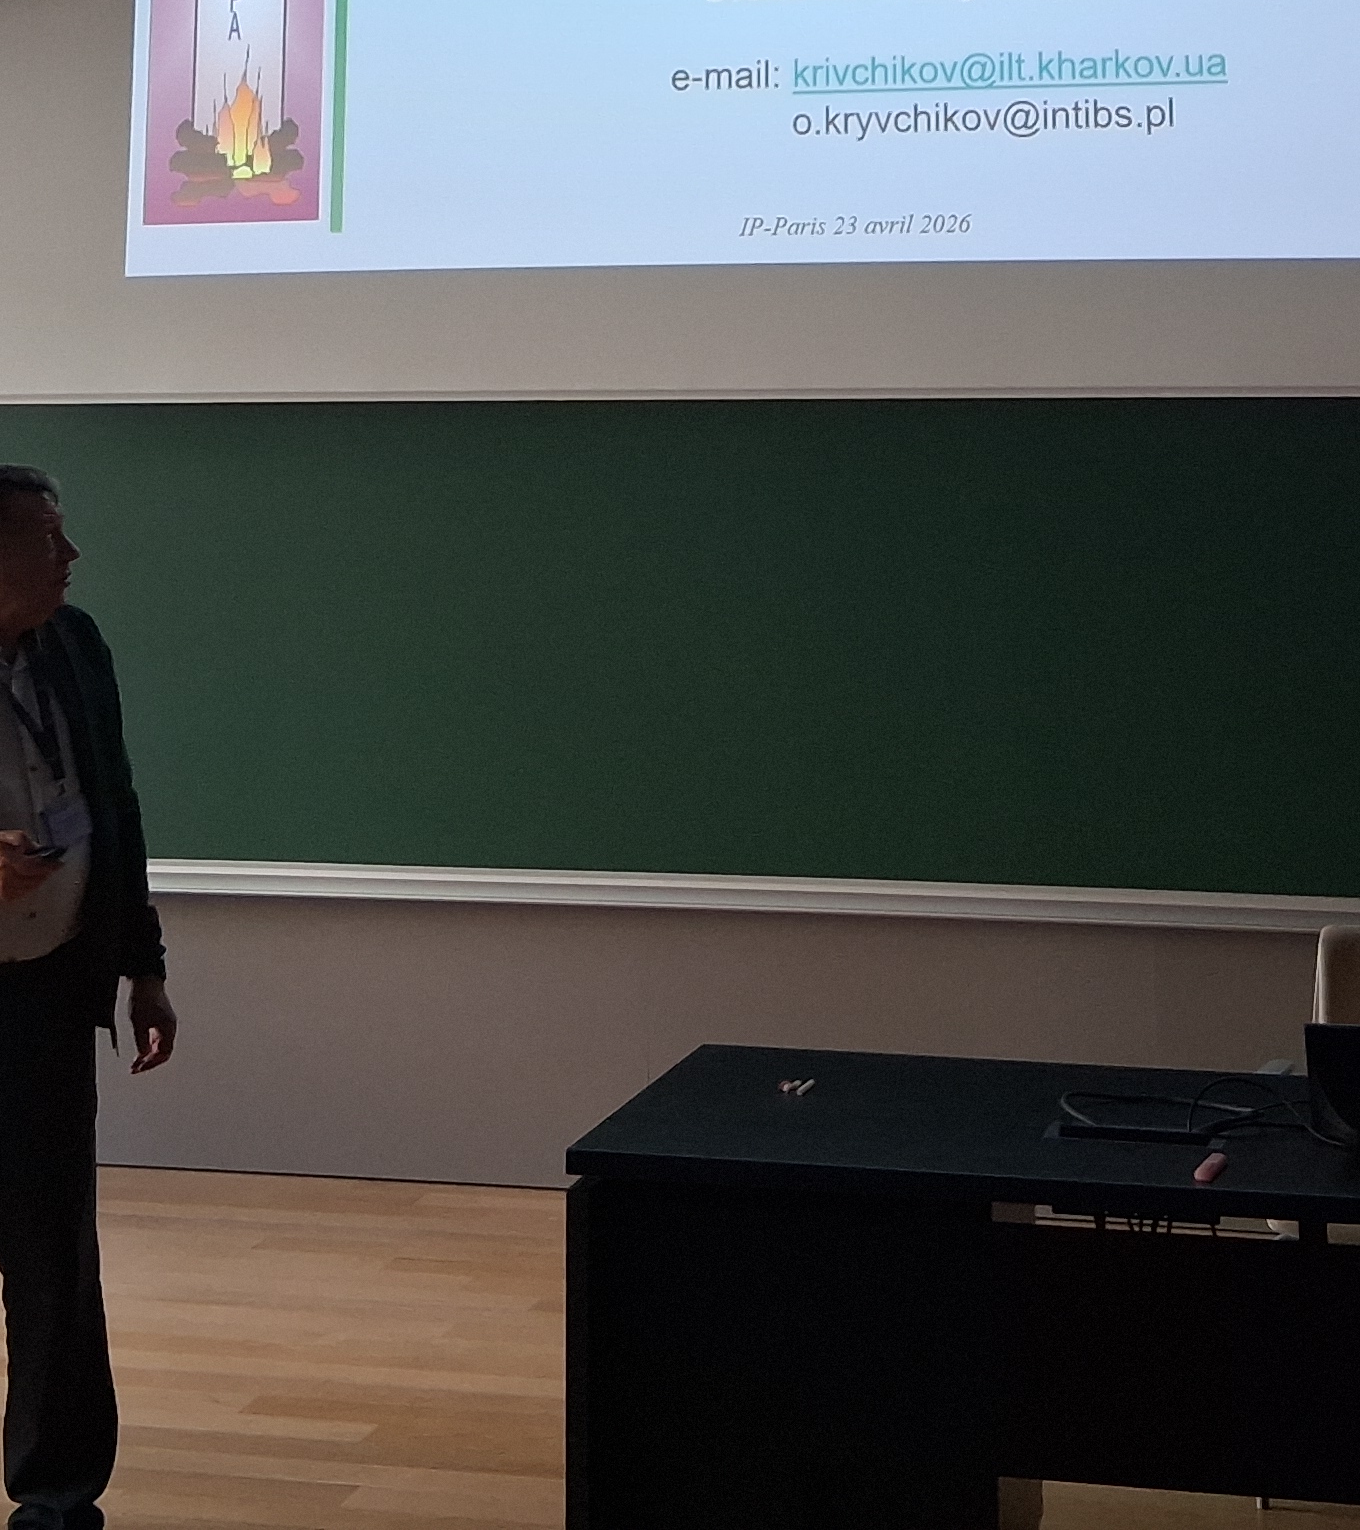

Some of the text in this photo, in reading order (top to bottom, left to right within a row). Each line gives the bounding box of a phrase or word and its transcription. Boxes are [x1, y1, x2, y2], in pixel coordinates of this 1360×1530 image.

[670, 48, 1229, 96] e-mail: krivchikov@ilt.kharkov.ua
[792, 96, 1175, 143] o.kryvchikov@intibs.pl
[738, 213, 973, 238] IP-Paris 23 avril 2026
